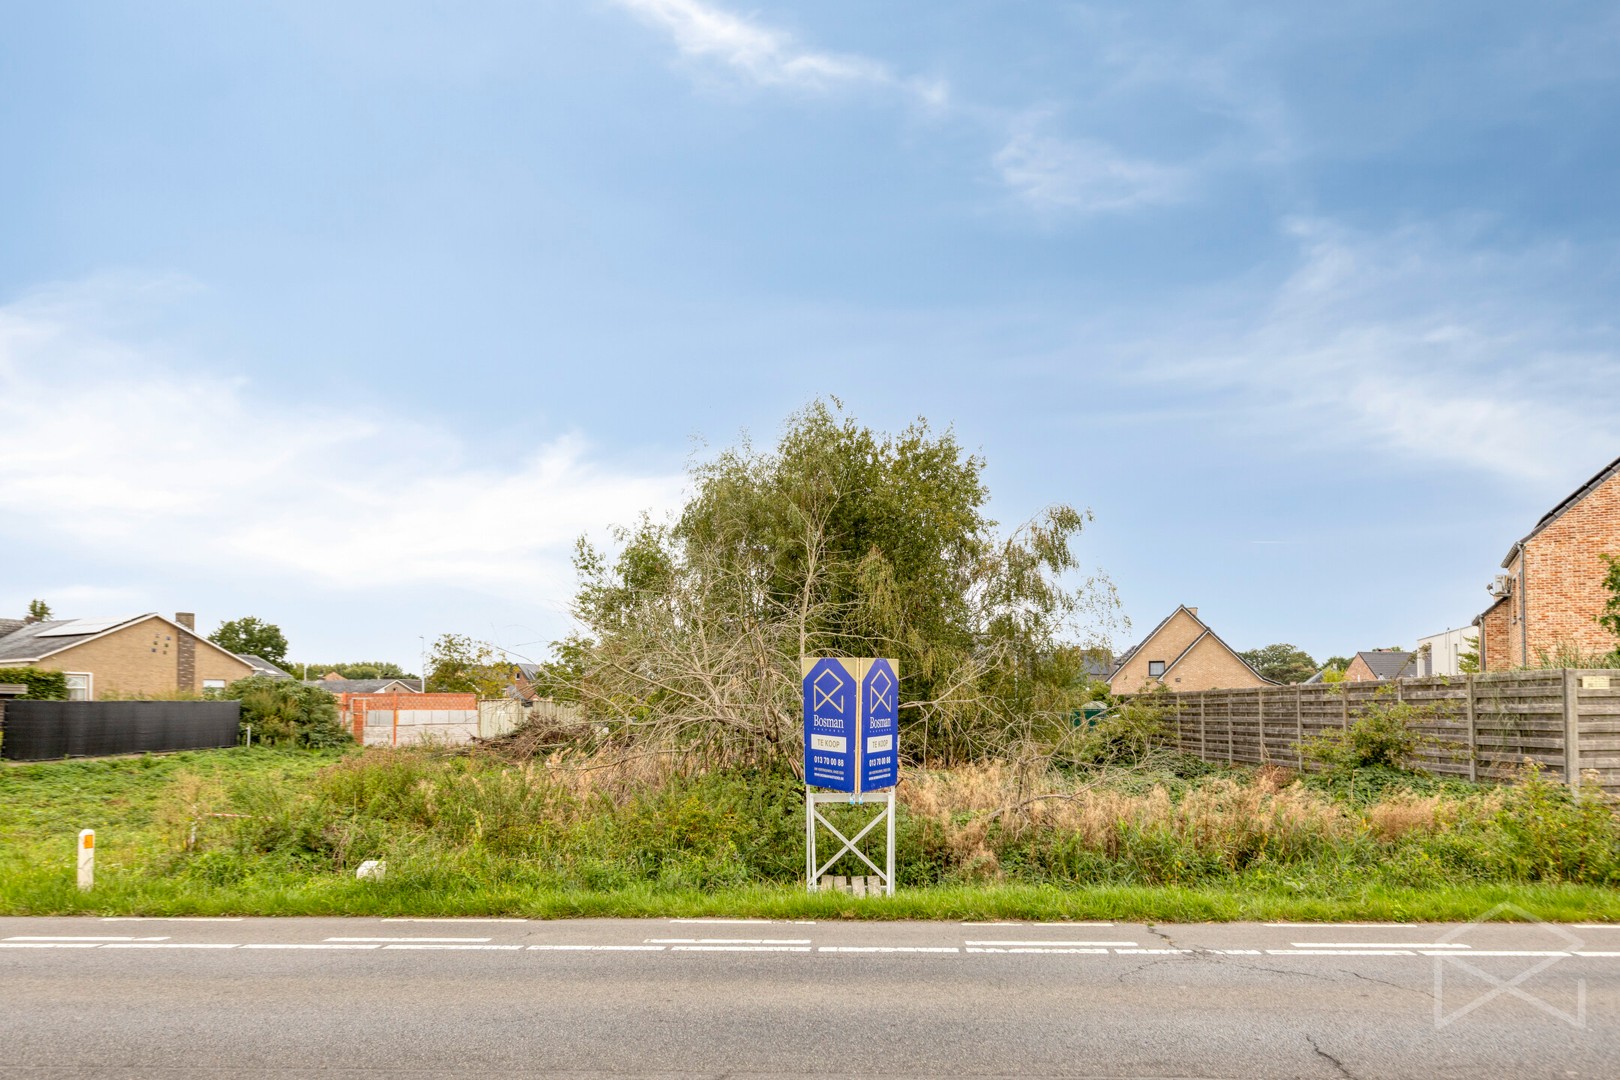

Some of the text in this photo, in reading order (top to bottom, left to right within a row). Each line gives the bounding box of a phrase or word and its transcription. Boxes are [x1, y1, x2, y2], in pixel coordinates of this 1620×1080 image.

[814, 715, 844, 728] Bosman
[870, 717, 891, 729] Bosman
[825, 739, 840, 748] KOOP
[814, 756, 823, 764] 013
[824, 757, 829, 765] 70
